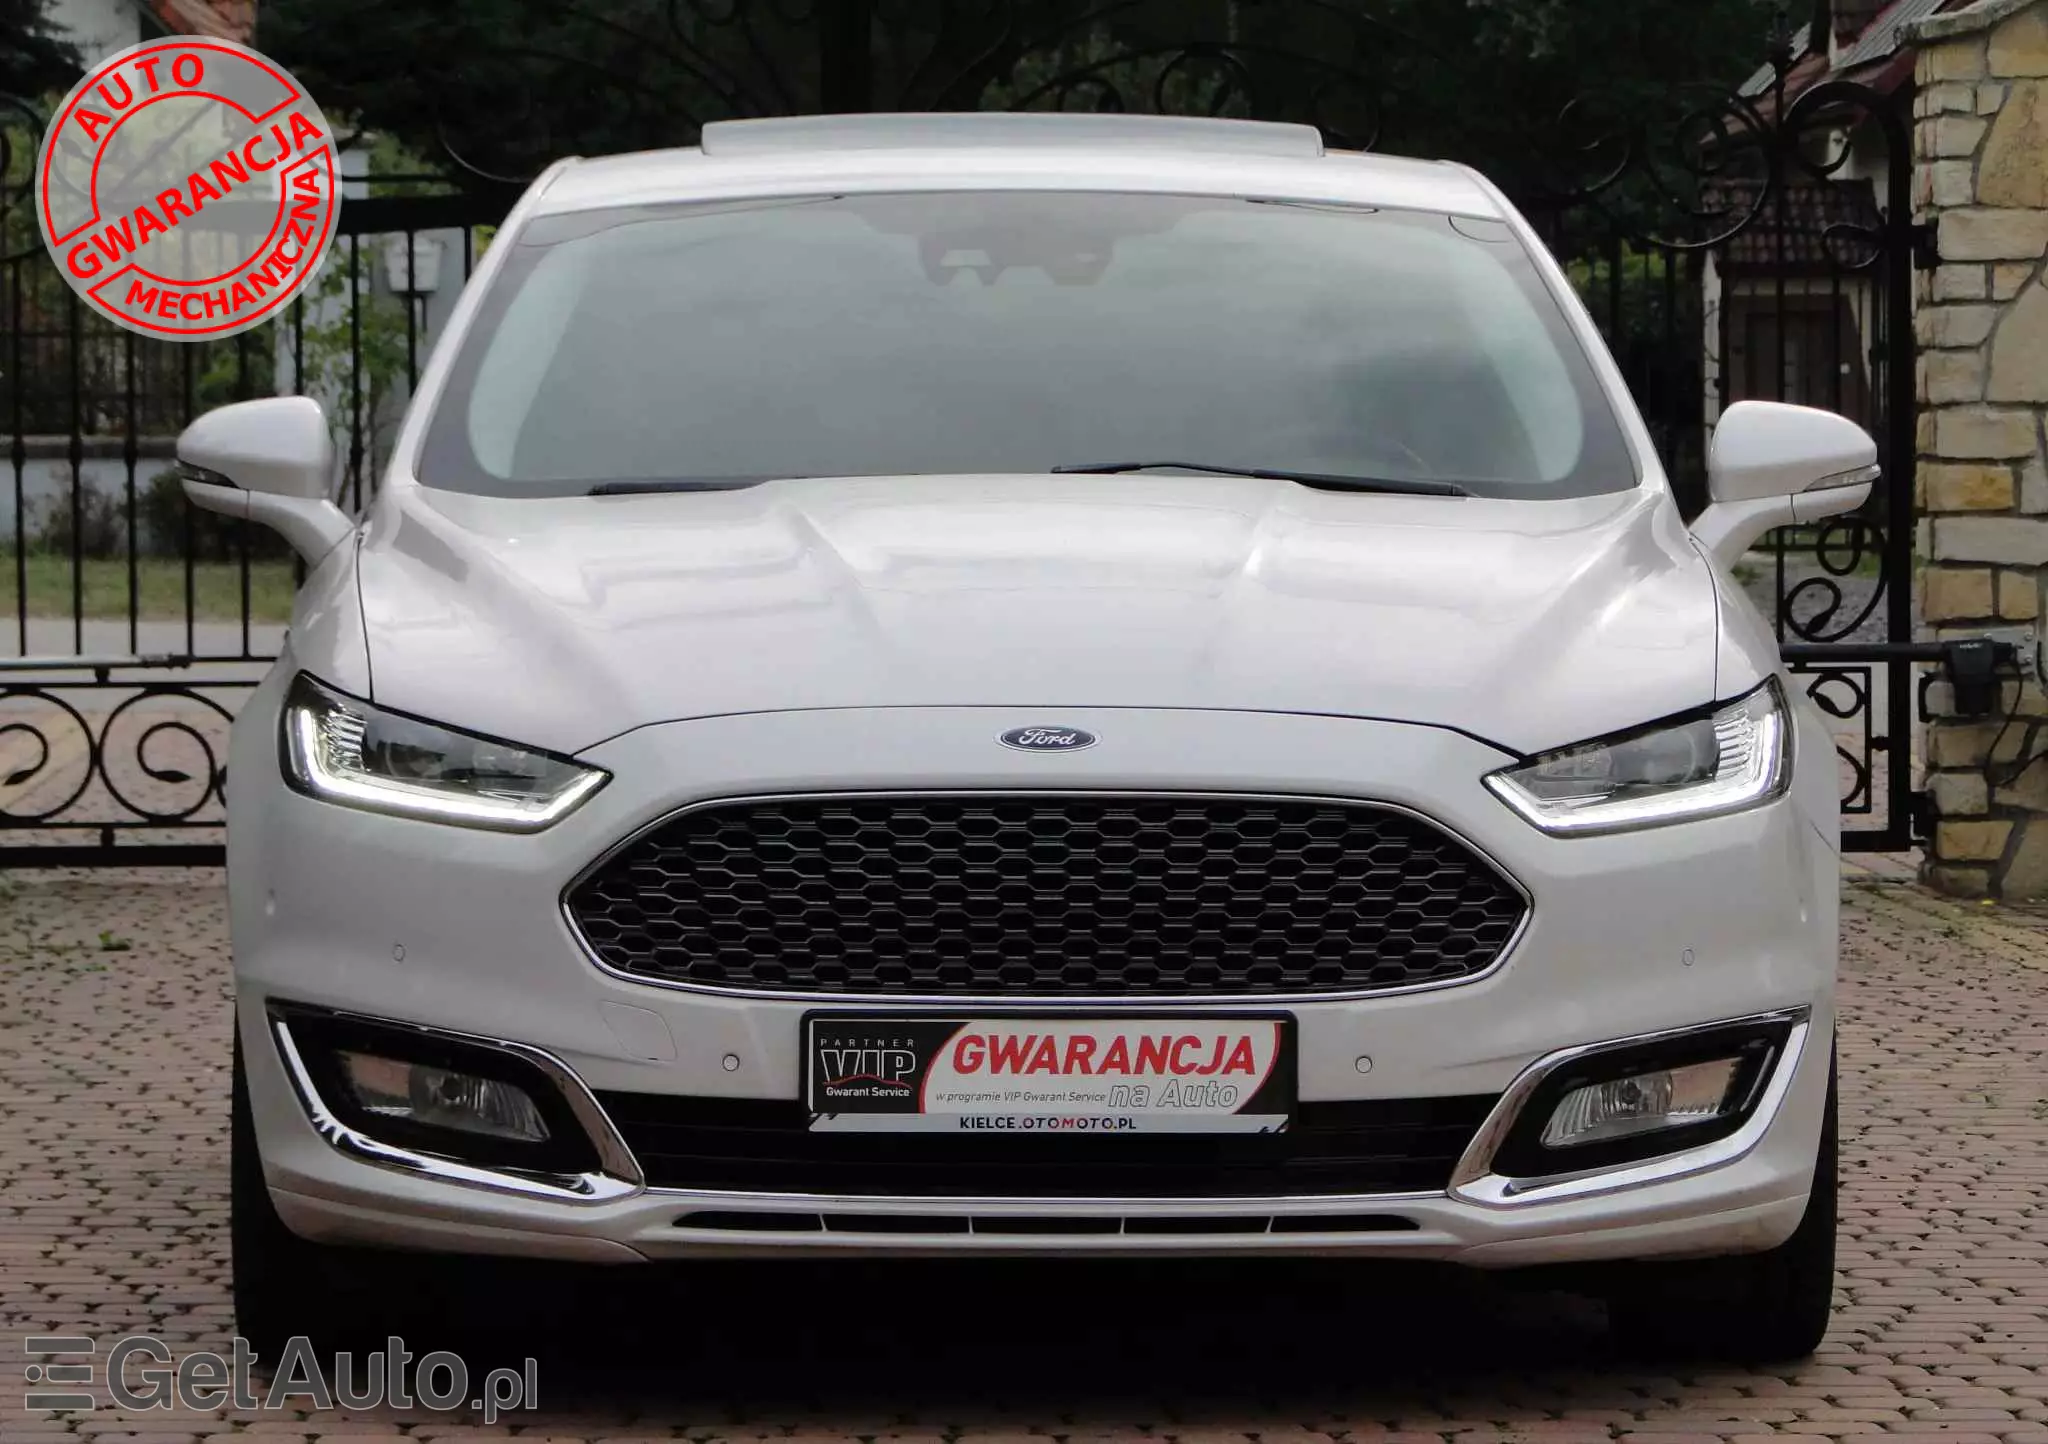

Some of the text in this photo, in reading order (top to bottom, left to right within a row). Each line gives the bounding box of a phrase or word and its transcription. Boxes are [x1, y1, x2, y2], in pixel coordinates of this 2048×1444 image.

[1018, 728, 1077, 745] Ford
[820, 1038, 914, 1047] PARTNER
[952, 1034, 1256, 1075] GWARANCJA
[820, 1049, 916, 1082] VIP
[826, 1087, 910, 1097] Gwarant Service
[947, 1091, 1000, 1103] programie
[1004, 1091, 1022, 1101] VIP
[1023, 1091, 1066, 1102] Gwarant
[1068, 1091, 1106, 1102] Service
[1108, 1078, 1239, 1108] na Auto
[959, 1116, 1137, 1130] KIELCE.OTOMOTO.PL
